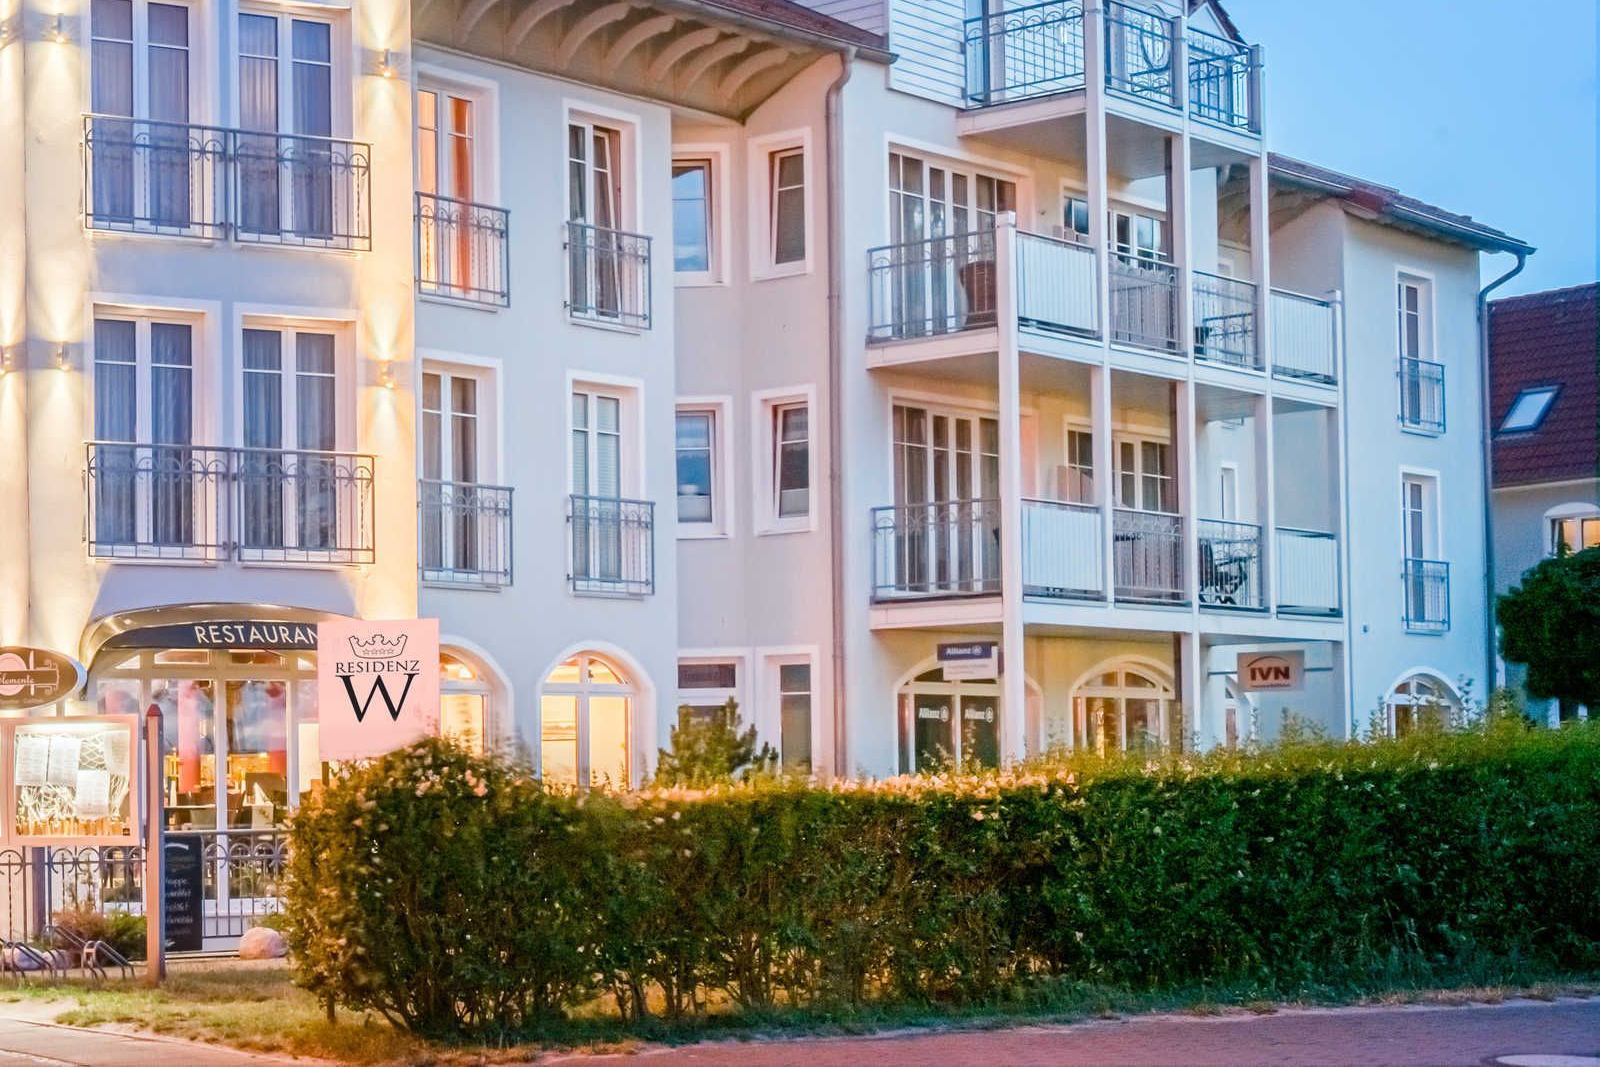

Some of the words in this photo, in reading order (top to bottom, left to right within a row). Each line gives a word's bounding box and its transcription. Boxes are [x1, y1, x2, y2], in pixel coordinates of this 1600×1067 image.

[335, 659, 421, 675] RESIDENZ
[1249, 665, 1291, 681] IVN
[335, 673, 421, 724] W
